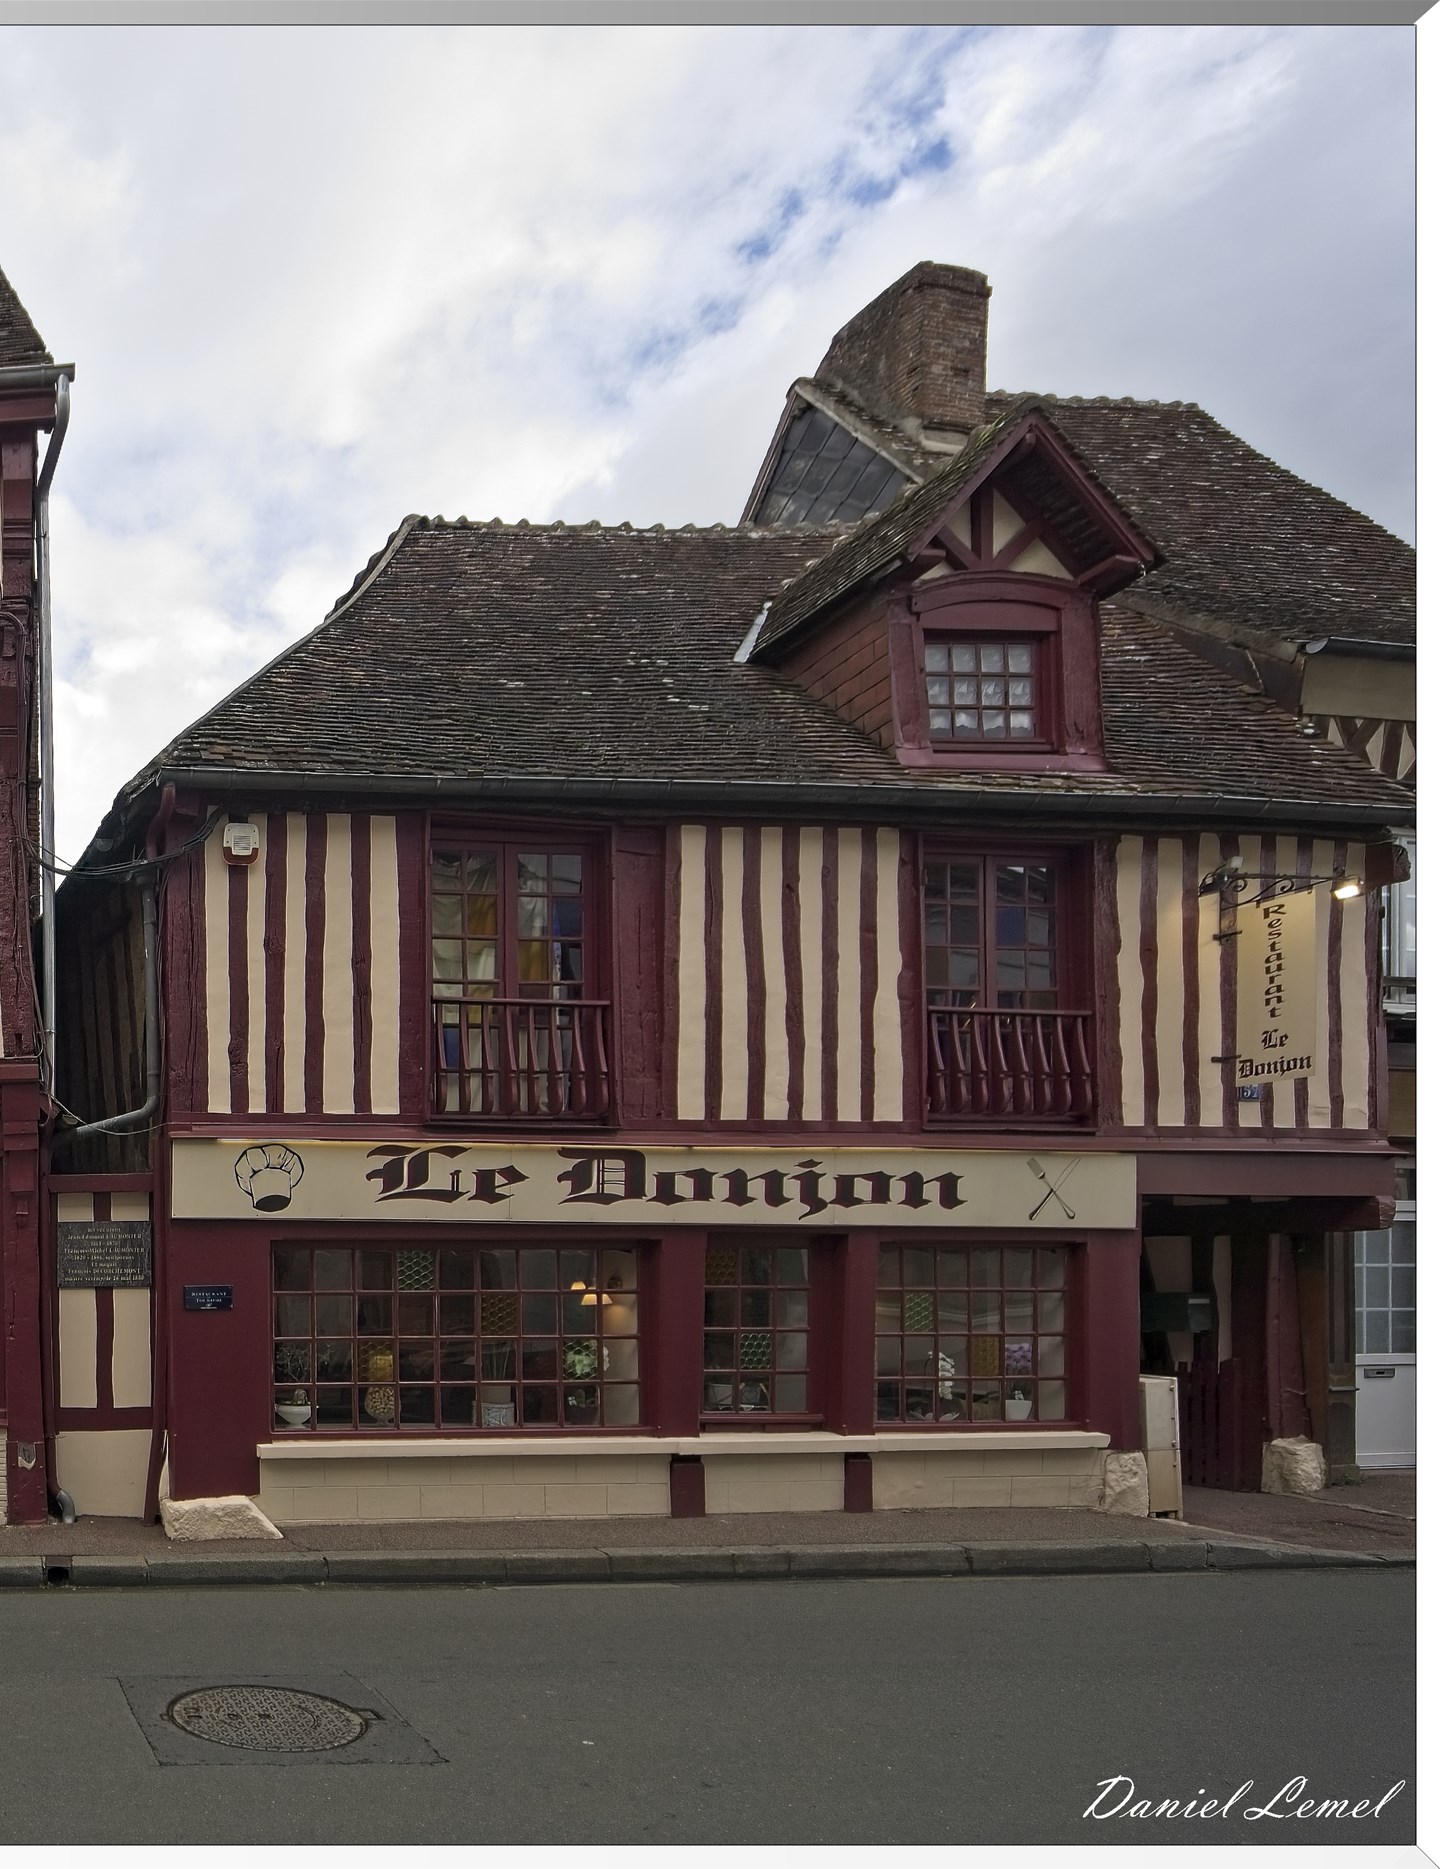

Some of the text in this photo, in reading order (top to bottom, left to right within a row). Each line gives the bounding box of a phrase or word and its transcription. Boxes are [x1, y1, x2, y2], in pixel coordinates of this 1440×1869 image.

[1263, 903, 1287, 1019] Restaurant
[1261, 1028, 1289, 1050] Le
[1238, 1054, 1312, 1079] Donjon
[365, 1143, 968, 1221] Le Donjon
